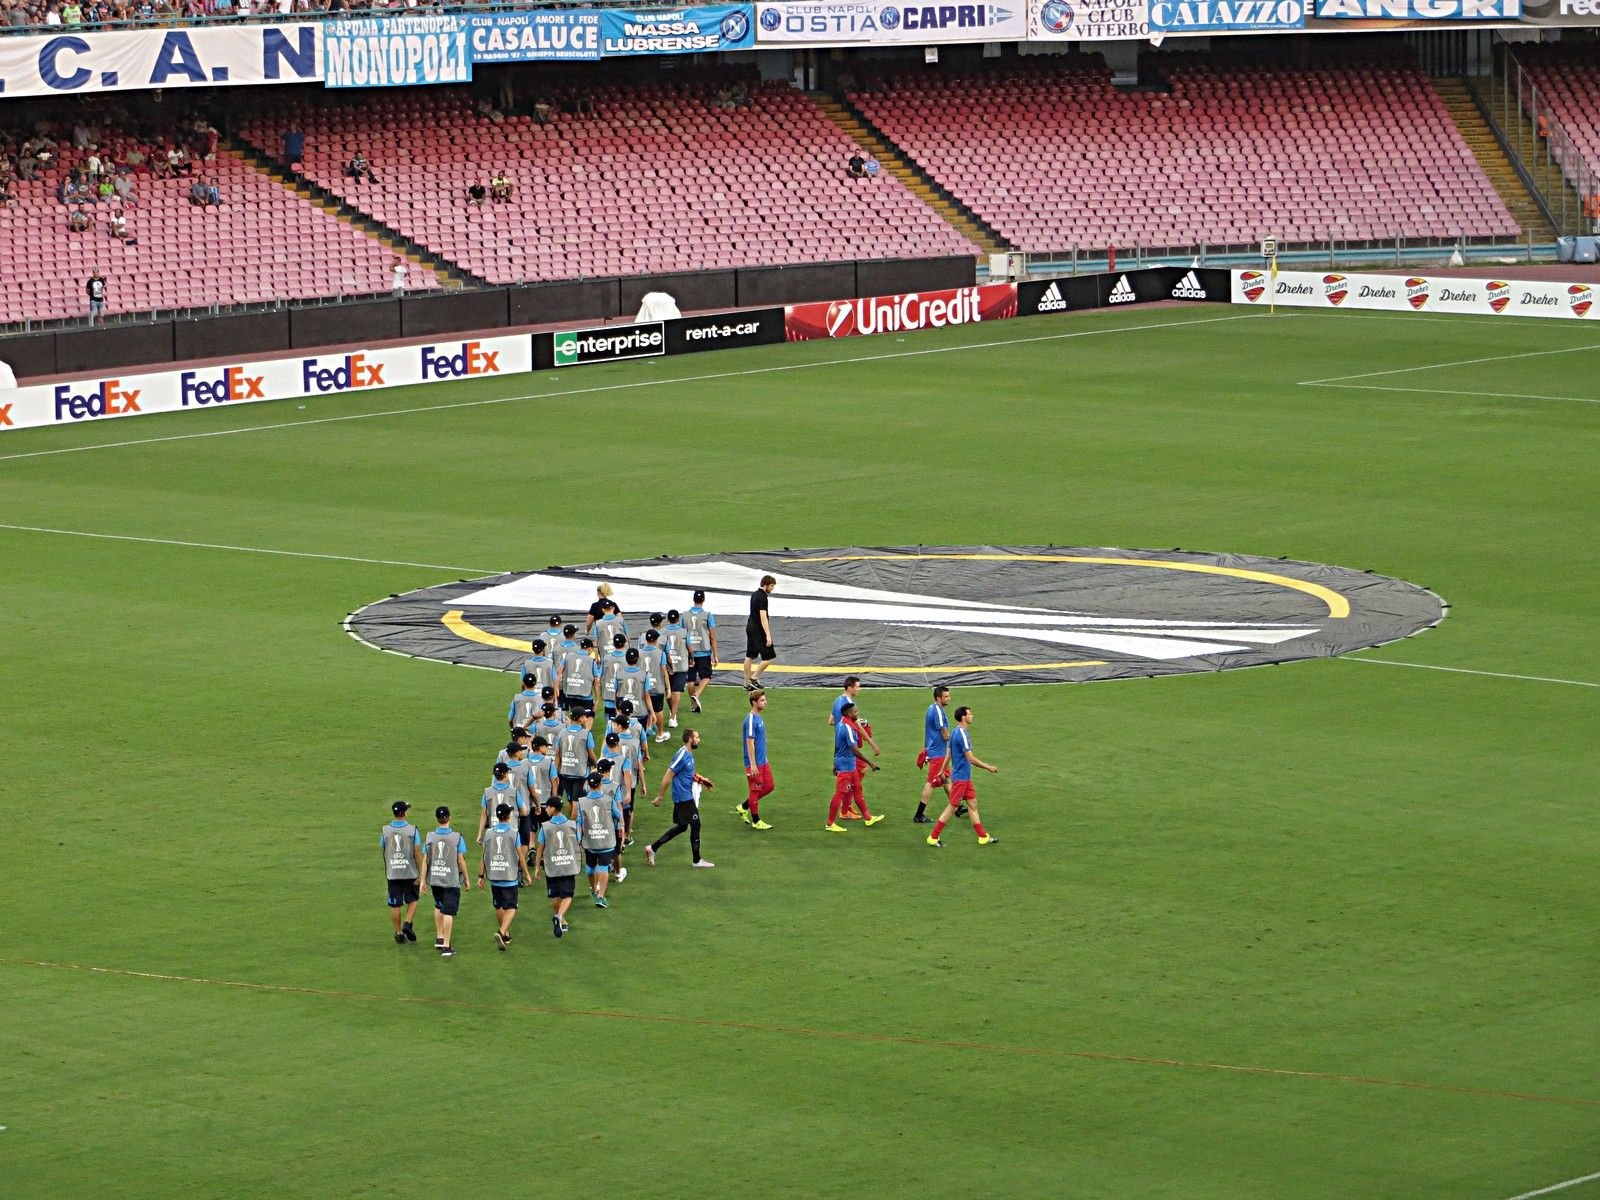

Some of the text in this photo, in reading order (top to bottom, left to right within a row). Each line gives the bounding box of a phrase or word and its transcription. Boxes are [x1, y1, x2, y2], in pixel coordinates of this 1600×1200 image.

[786, 5, 877, 15] CLUB NAPOLI
[1079, 0, 1144, 9] NAPOLI
[1317, 0, 1520, 17] ANGRI
[472, 15, 599, 26] CLUB NAPOLI AMORE E FEDE
[635, 12, 684, 22] CLUB NAPOLI
[902, 4, 986, 30] CAPRI
[1088, 8, 1134, 23] CLUB
[1151, 0, 1301, 27] CAIAZZO
[336, 15, 458, 37] APULIA PARTENOPEA
[623, 22, 700, 36] MASSA
[785, 15, 878, 33] OSTIA
[1075, 22, 1150, 37] VITERBO
[472, 26, 598, 51] CASALUCE
[605, 35, 720, 51] LUBRENSE
[326, 32, 467, 86] MONOPOLI
[1241, 278, 1265, 290] Dreher
[1275, 281, 1314, 295] Dreher
[1324, 282, 1348, 293] Dreher
[1406, 285, 1429, 297] Dreher
[1108, 292, 1136, 304] adidas
[1171, 288, 1206, 299] adidas
[1358, 285, 1396, 298] Dreher
[1439, 288, 1477, 302] Dreher
[1487, 288, 1510, 300] Dreher
[1520, 292, 1559, 305] Dreher
[1569, 292, 1592, 304] Dreher
[857, 287, 982, 335] UniCredit
[1037, 300, 1067, 312] adidas
[685, 321, 760, 341] rent-a-car
[561, 330, 662, 356] enterprise
[421, 341, 501, 380] FedEx
[302, 353, 385, 393] FedEx
[181, 366, 265, 406] FedEx
[54, 379, 142, 421] FedEx
